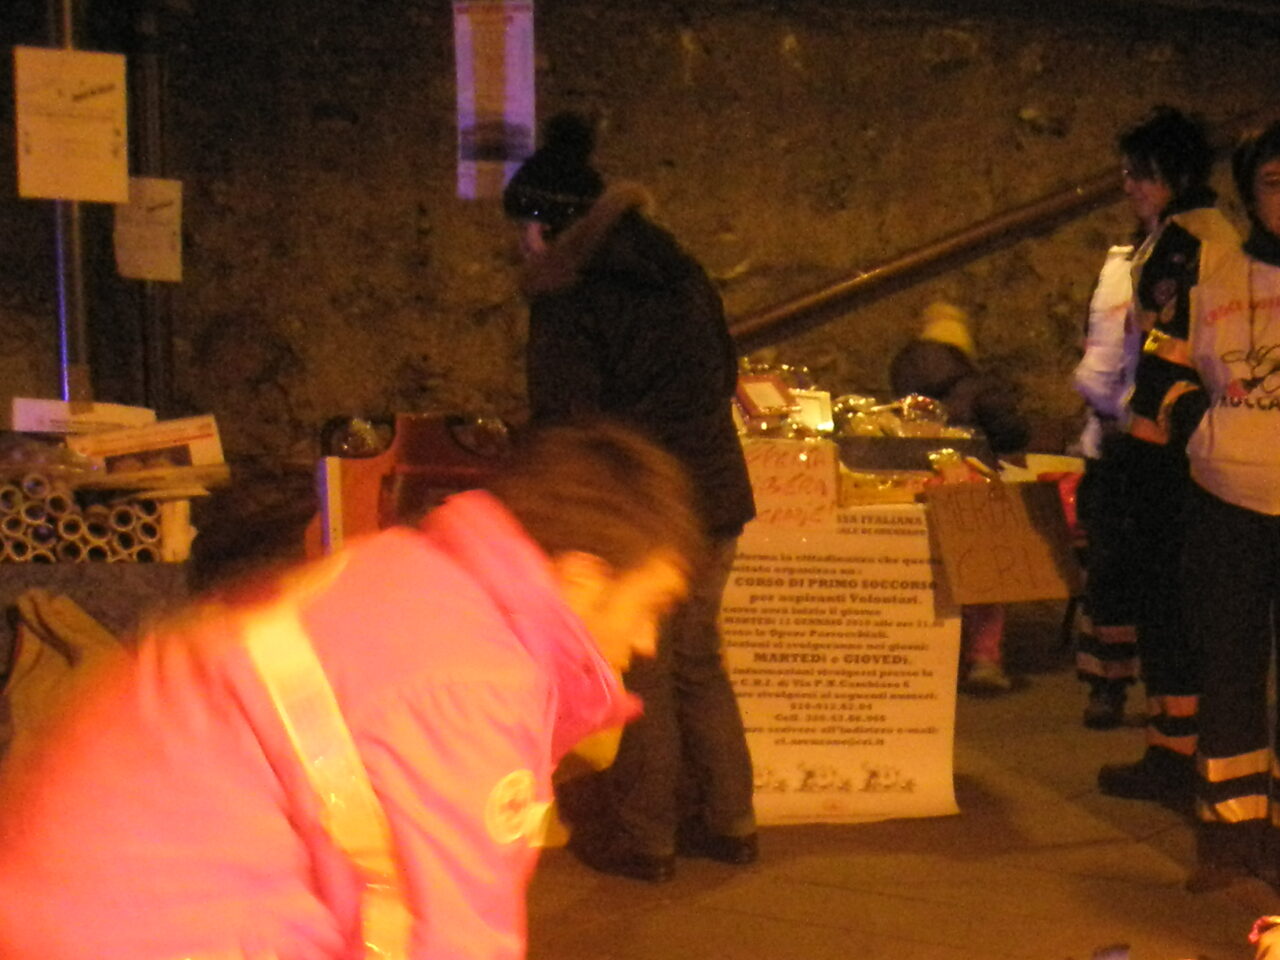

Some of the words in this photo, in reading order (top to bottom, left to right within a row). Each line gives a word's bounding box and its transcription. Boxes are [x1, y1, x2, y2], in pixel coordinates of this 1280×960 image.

[734, 577, 785, 587] CORSO
[788, 578, 805, 588] DI
[807, 579, 858, 589] PRIMO
[861, 580, 939, 590] SOCCORSO
[749, 594, 775, 605] per
[777, 592, 846, 605] aspiranti
[830, 655, 839, 665] e
